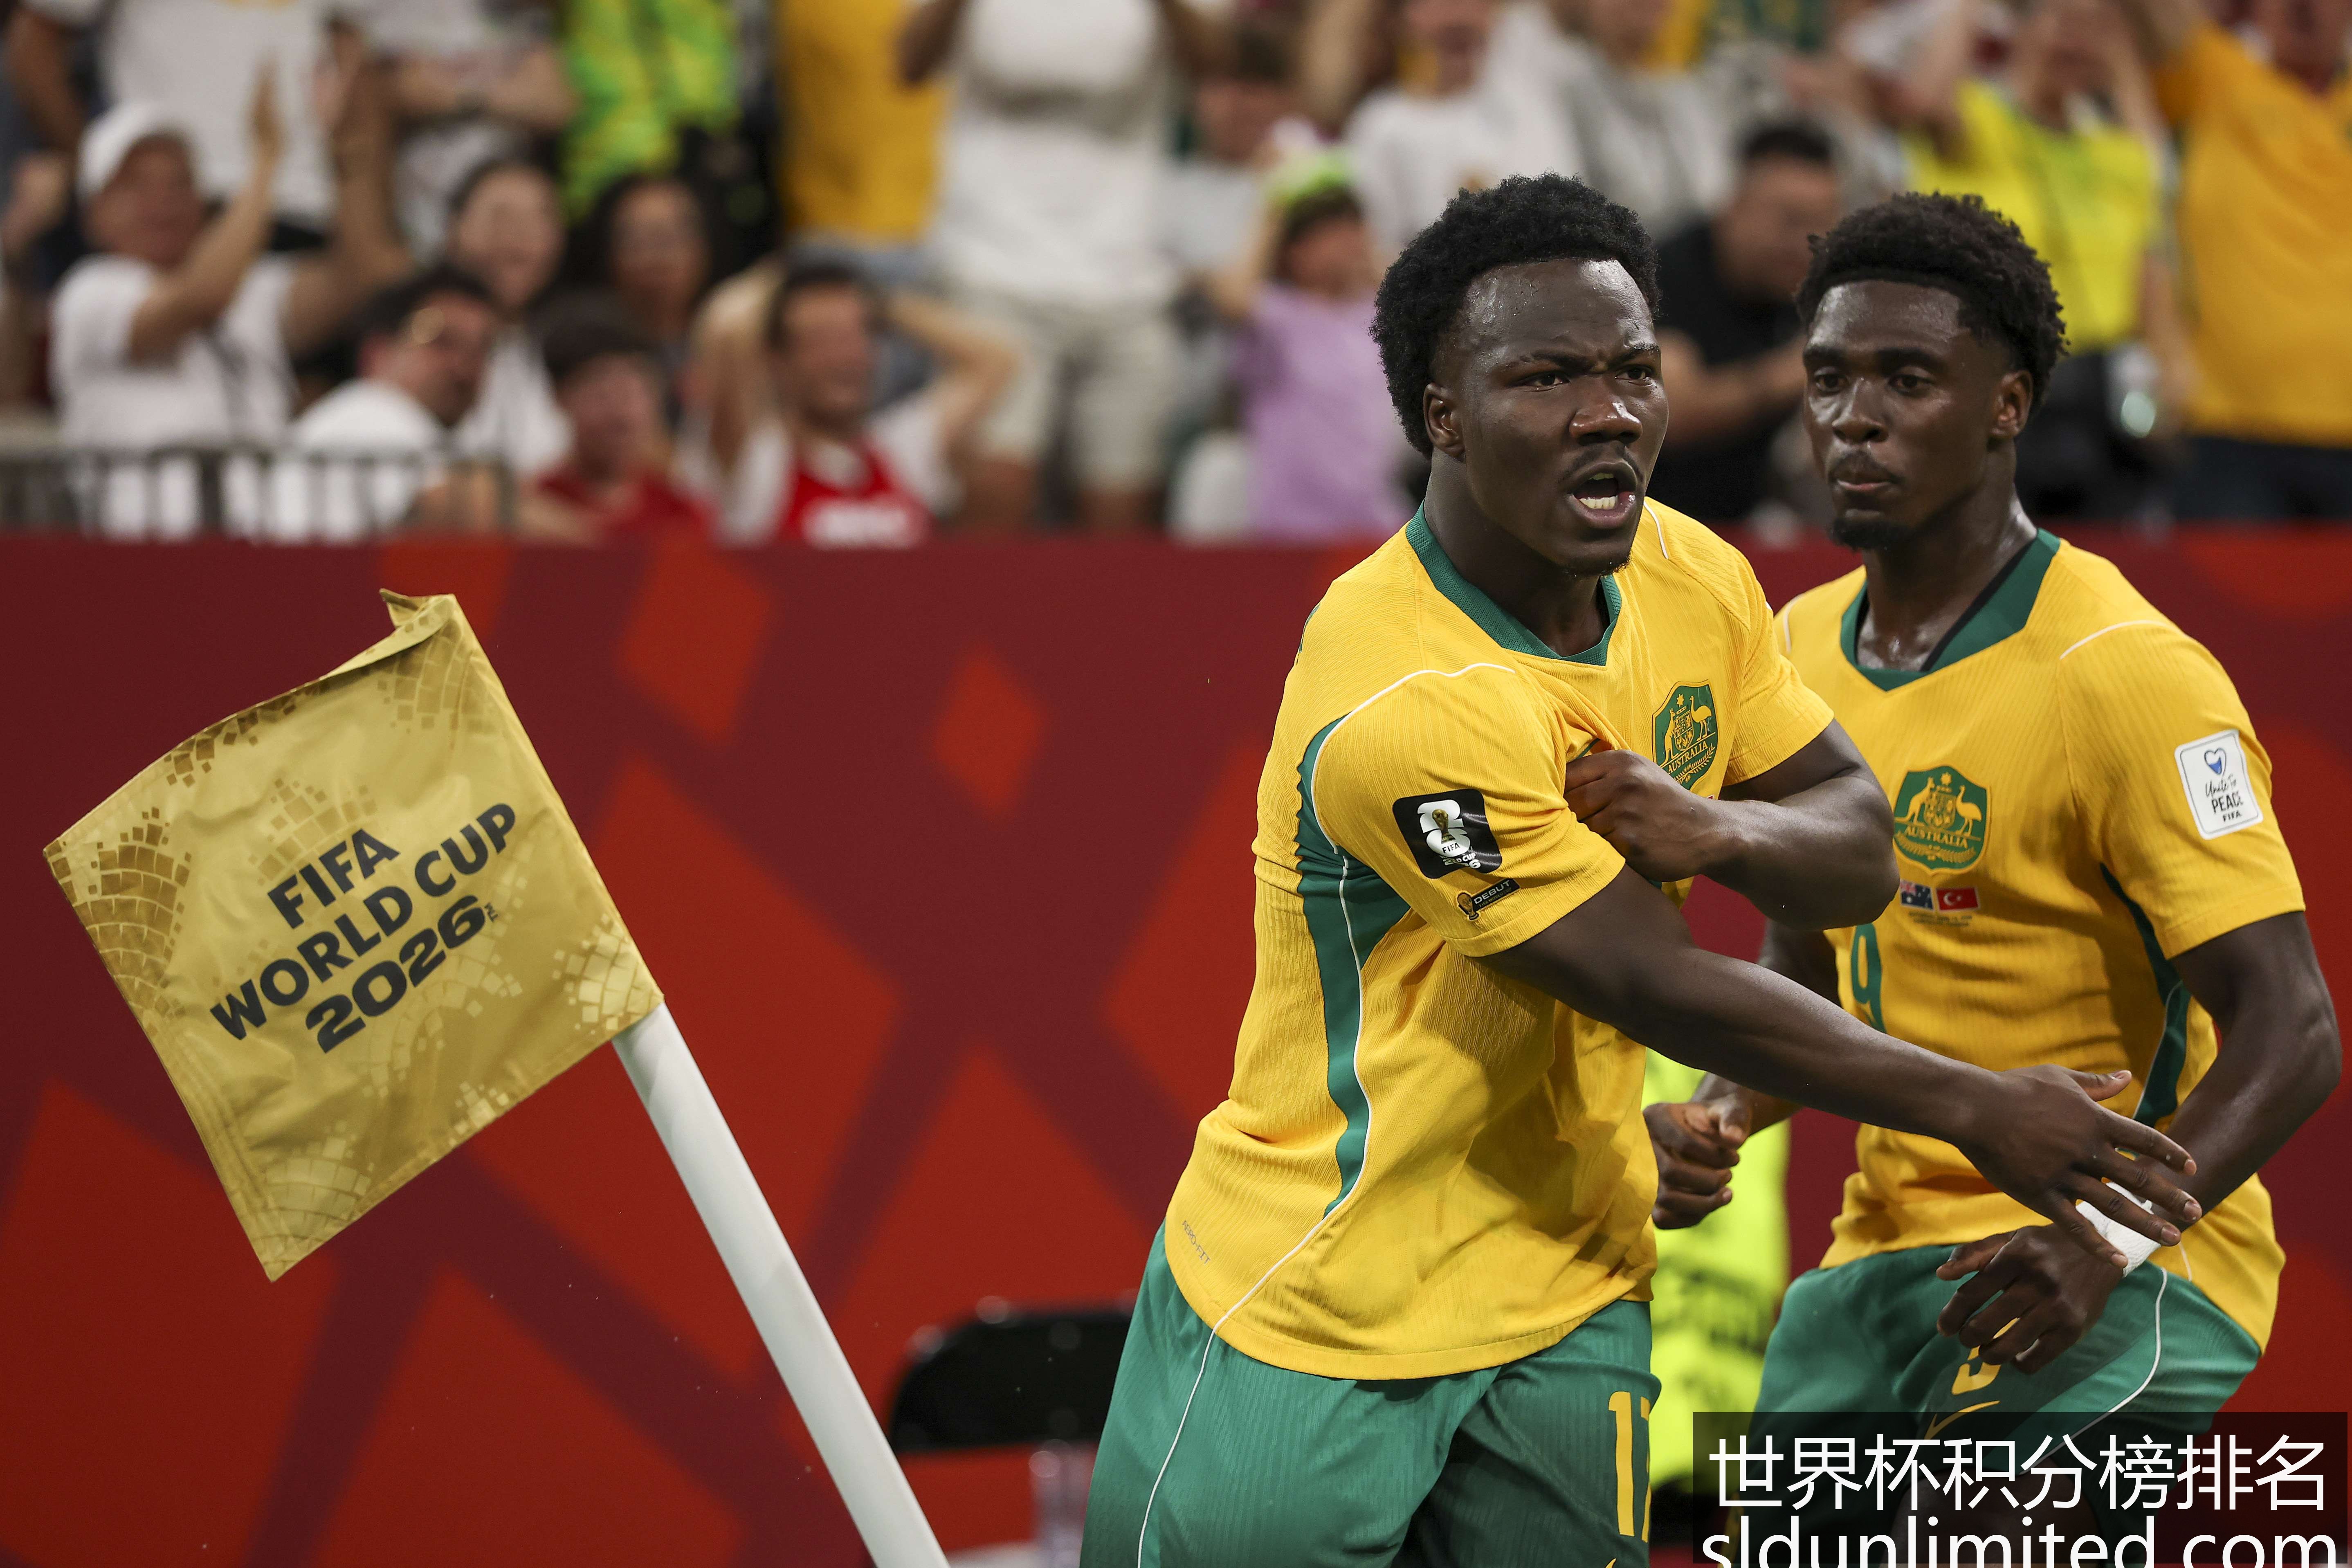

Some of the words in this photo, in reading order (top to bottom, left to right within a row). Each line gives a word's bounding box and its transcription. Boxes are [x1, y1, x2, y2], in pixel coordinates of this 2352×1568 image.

[1668, 741, 1708, 774] AUSTRALIA
[2212, 791, 2244, 813] PEACE
[2222, 810, 2242, 822] FIFA
[1442, 843, 1460, 854] FIFA
[1904, 825, 1968, 849] AUSTRALIA
[1462, 853, 1476, 862] CUP
[267, 829, 400, 929] FIFA
[1474, 880, 1510, 904] DEBUT
[210, 886, 413, 1040] WORLD
[414, 803, 516, 897] CUP
[306, 895, 485, 1054] 2026
[1851, 923, 1887, 1034] 9
